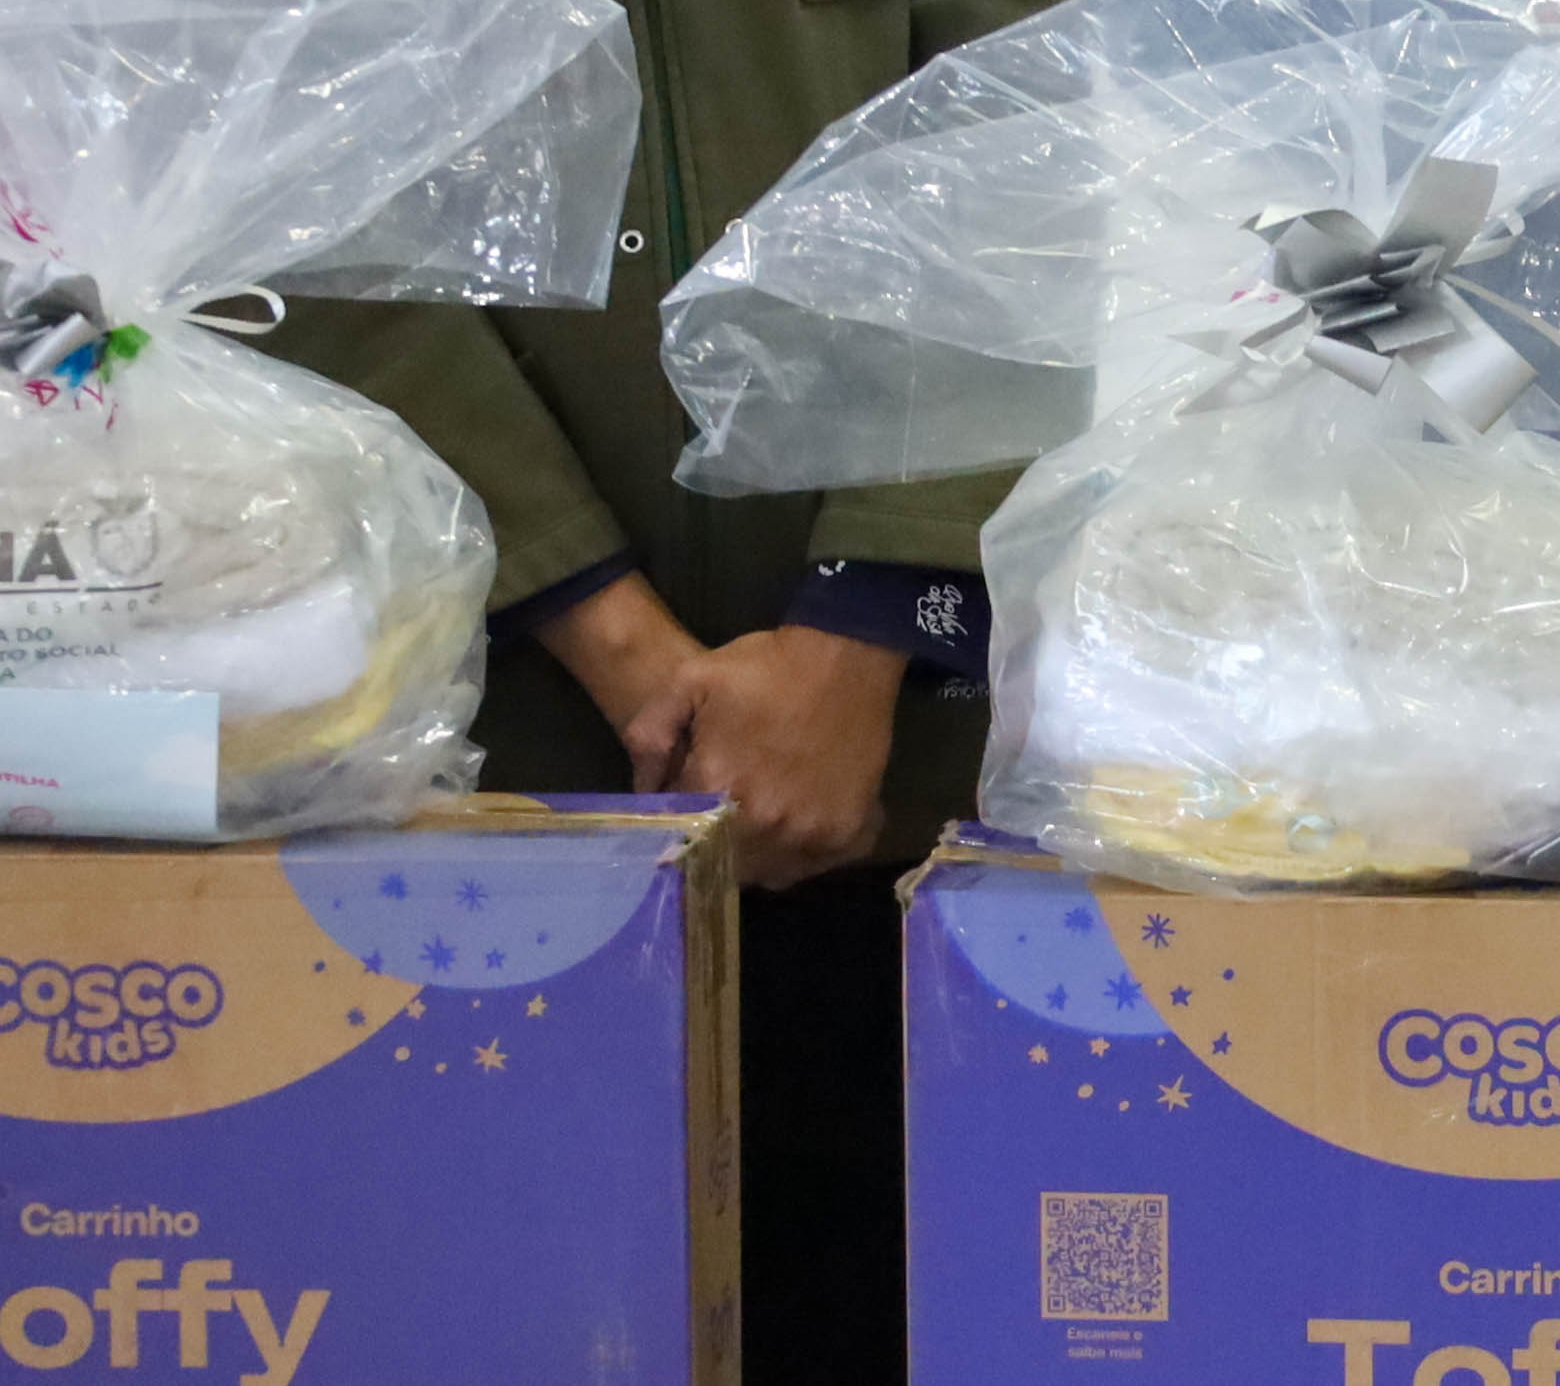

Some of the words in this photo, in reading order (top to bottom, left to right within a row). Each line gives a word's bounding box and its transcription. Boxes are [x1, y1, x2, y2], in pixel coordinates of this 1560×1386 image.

[16, 626, 55, 644] DO
[34, 642, 121, 663] SOCIAL
[45, 1016, 176, 1073] kids
[20, 1203, 200, 1240] Carrinho
